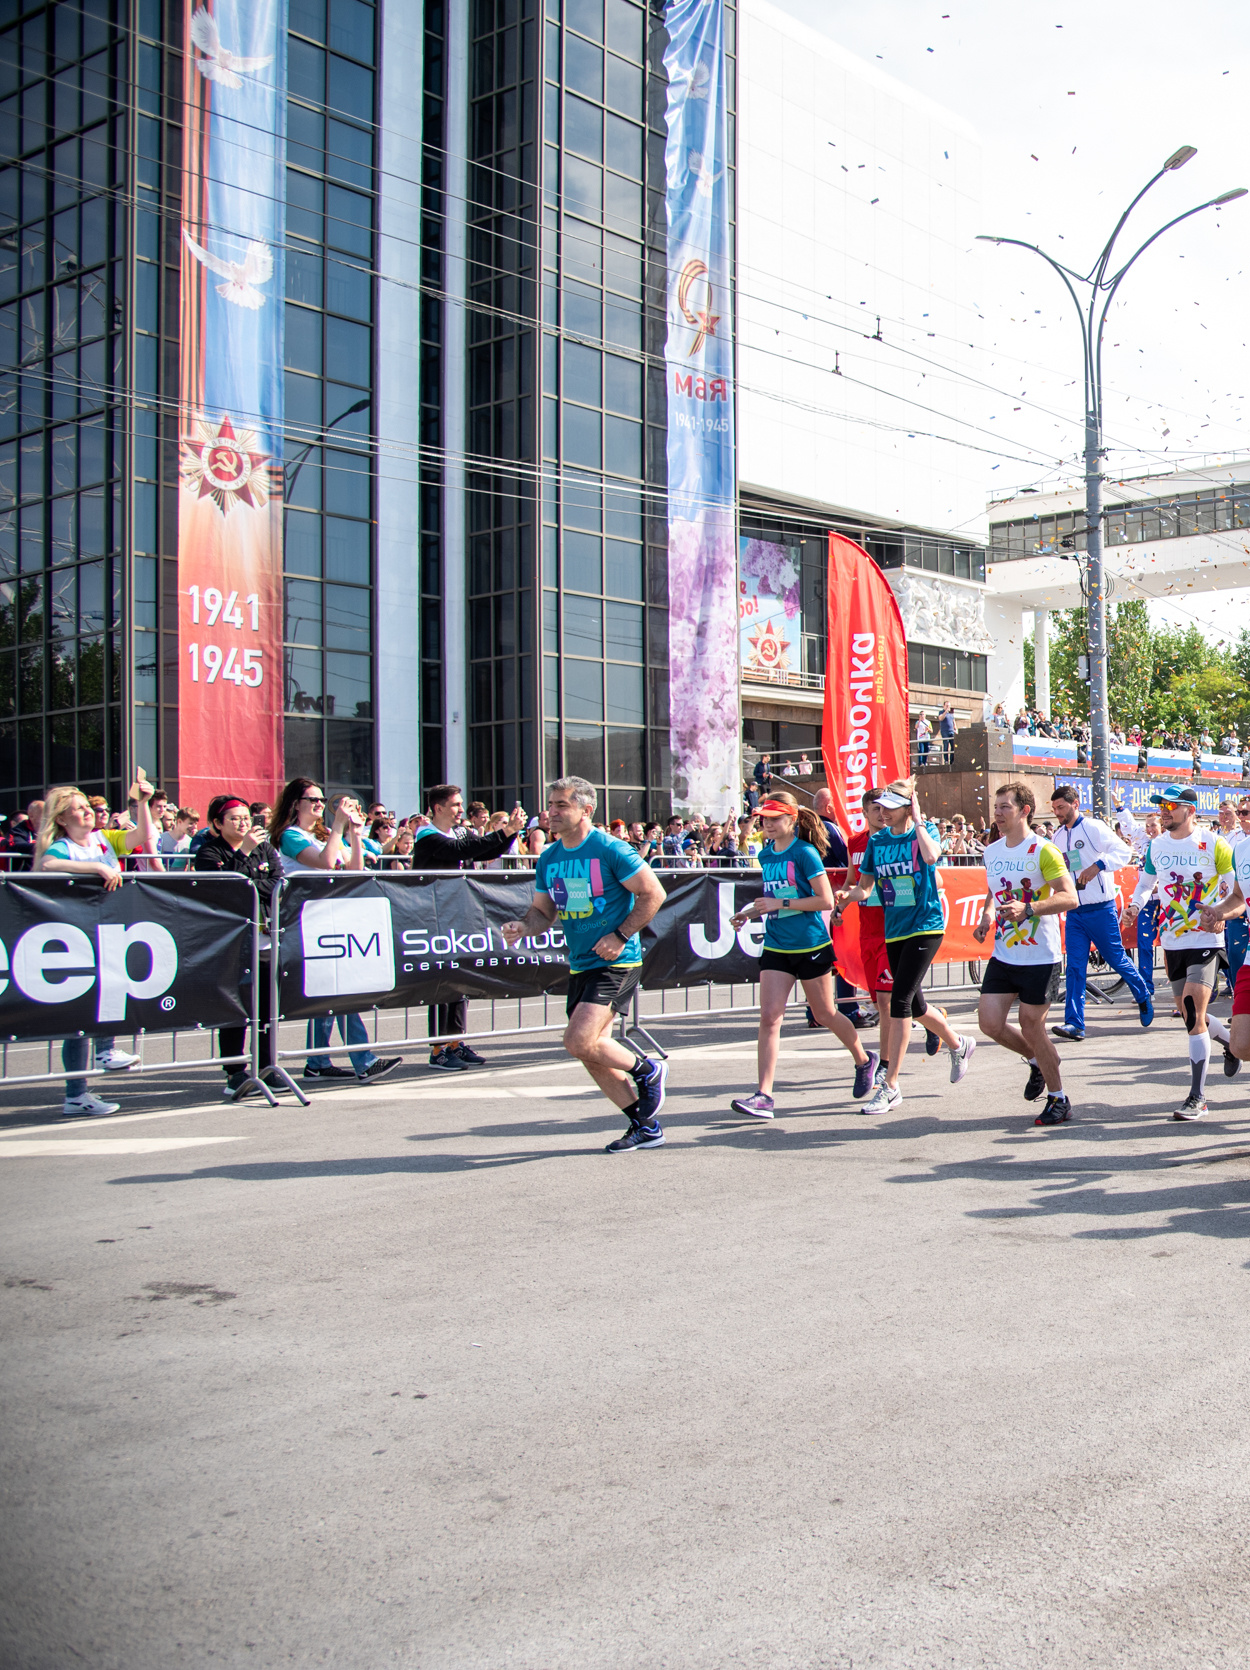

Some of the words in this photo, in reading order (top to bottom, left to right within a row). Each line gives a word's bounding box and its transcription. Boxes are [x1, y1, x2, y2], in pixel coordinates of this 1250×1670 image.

[674, 411, 729, 433] 1941-1945
[189, 585, 259, 631] 1941
[189, 643, 263, 687] 1945
[875, 841, 913, 866] RUN
[569, 890, 587, 899] 00001
[304, 932, 381, 961] SM
[402, 927, 494, 956] Sokol
[0, 921, 178, 1023] ep
[403, 960, 460, 972] сеть
